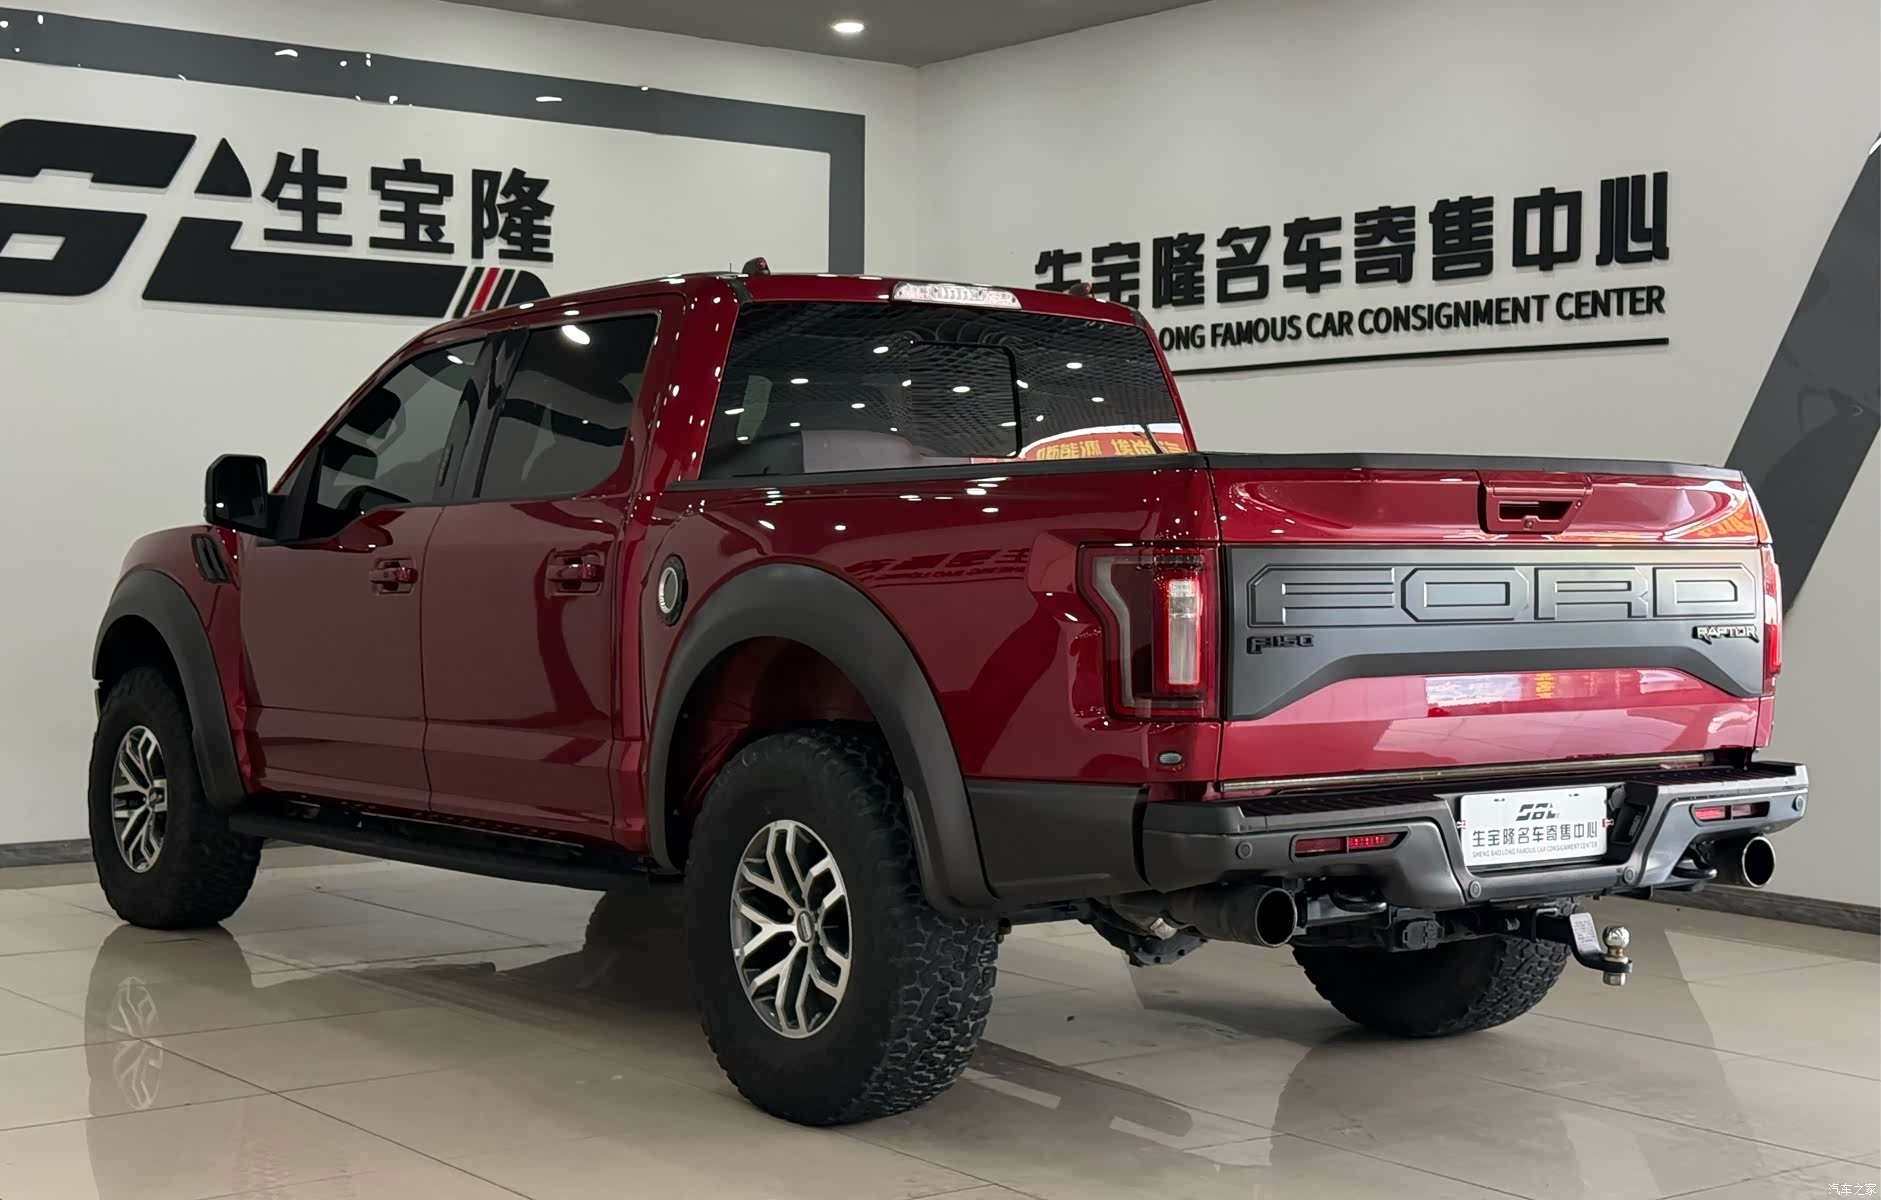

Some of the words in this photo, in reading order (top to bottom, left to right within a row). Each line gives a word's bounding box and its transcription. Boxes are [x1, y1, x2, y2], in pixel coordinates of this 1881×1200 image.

[261, 147, 555, 263] 生宝隆
[1035, 171, 1669, 309] 生宝隆名车寄售中心
[1159, 325, 1205, 350] ONG
[1210, 315, 1302, 348] FAMOUS
[1306, 311, 1354, 339] CAR
[1358, 294, 1550, 335] CONSIGNMENT
[1556, 285, 1666, 321] CENTER
[1247, 564, 1757, 627] FORD
[1692, 624, 1760, 645] RAPTOR
[1472, 820, 1598, 847] 生宝隆名车寄售中心
[1516, 846, 1536, 855] FAMOUS
[1537, 845, 1546, 853] CAR
[1546, 842, 1579, 852] CONSIGNMENT
[1580, 841, 1598, 849] CENTER
